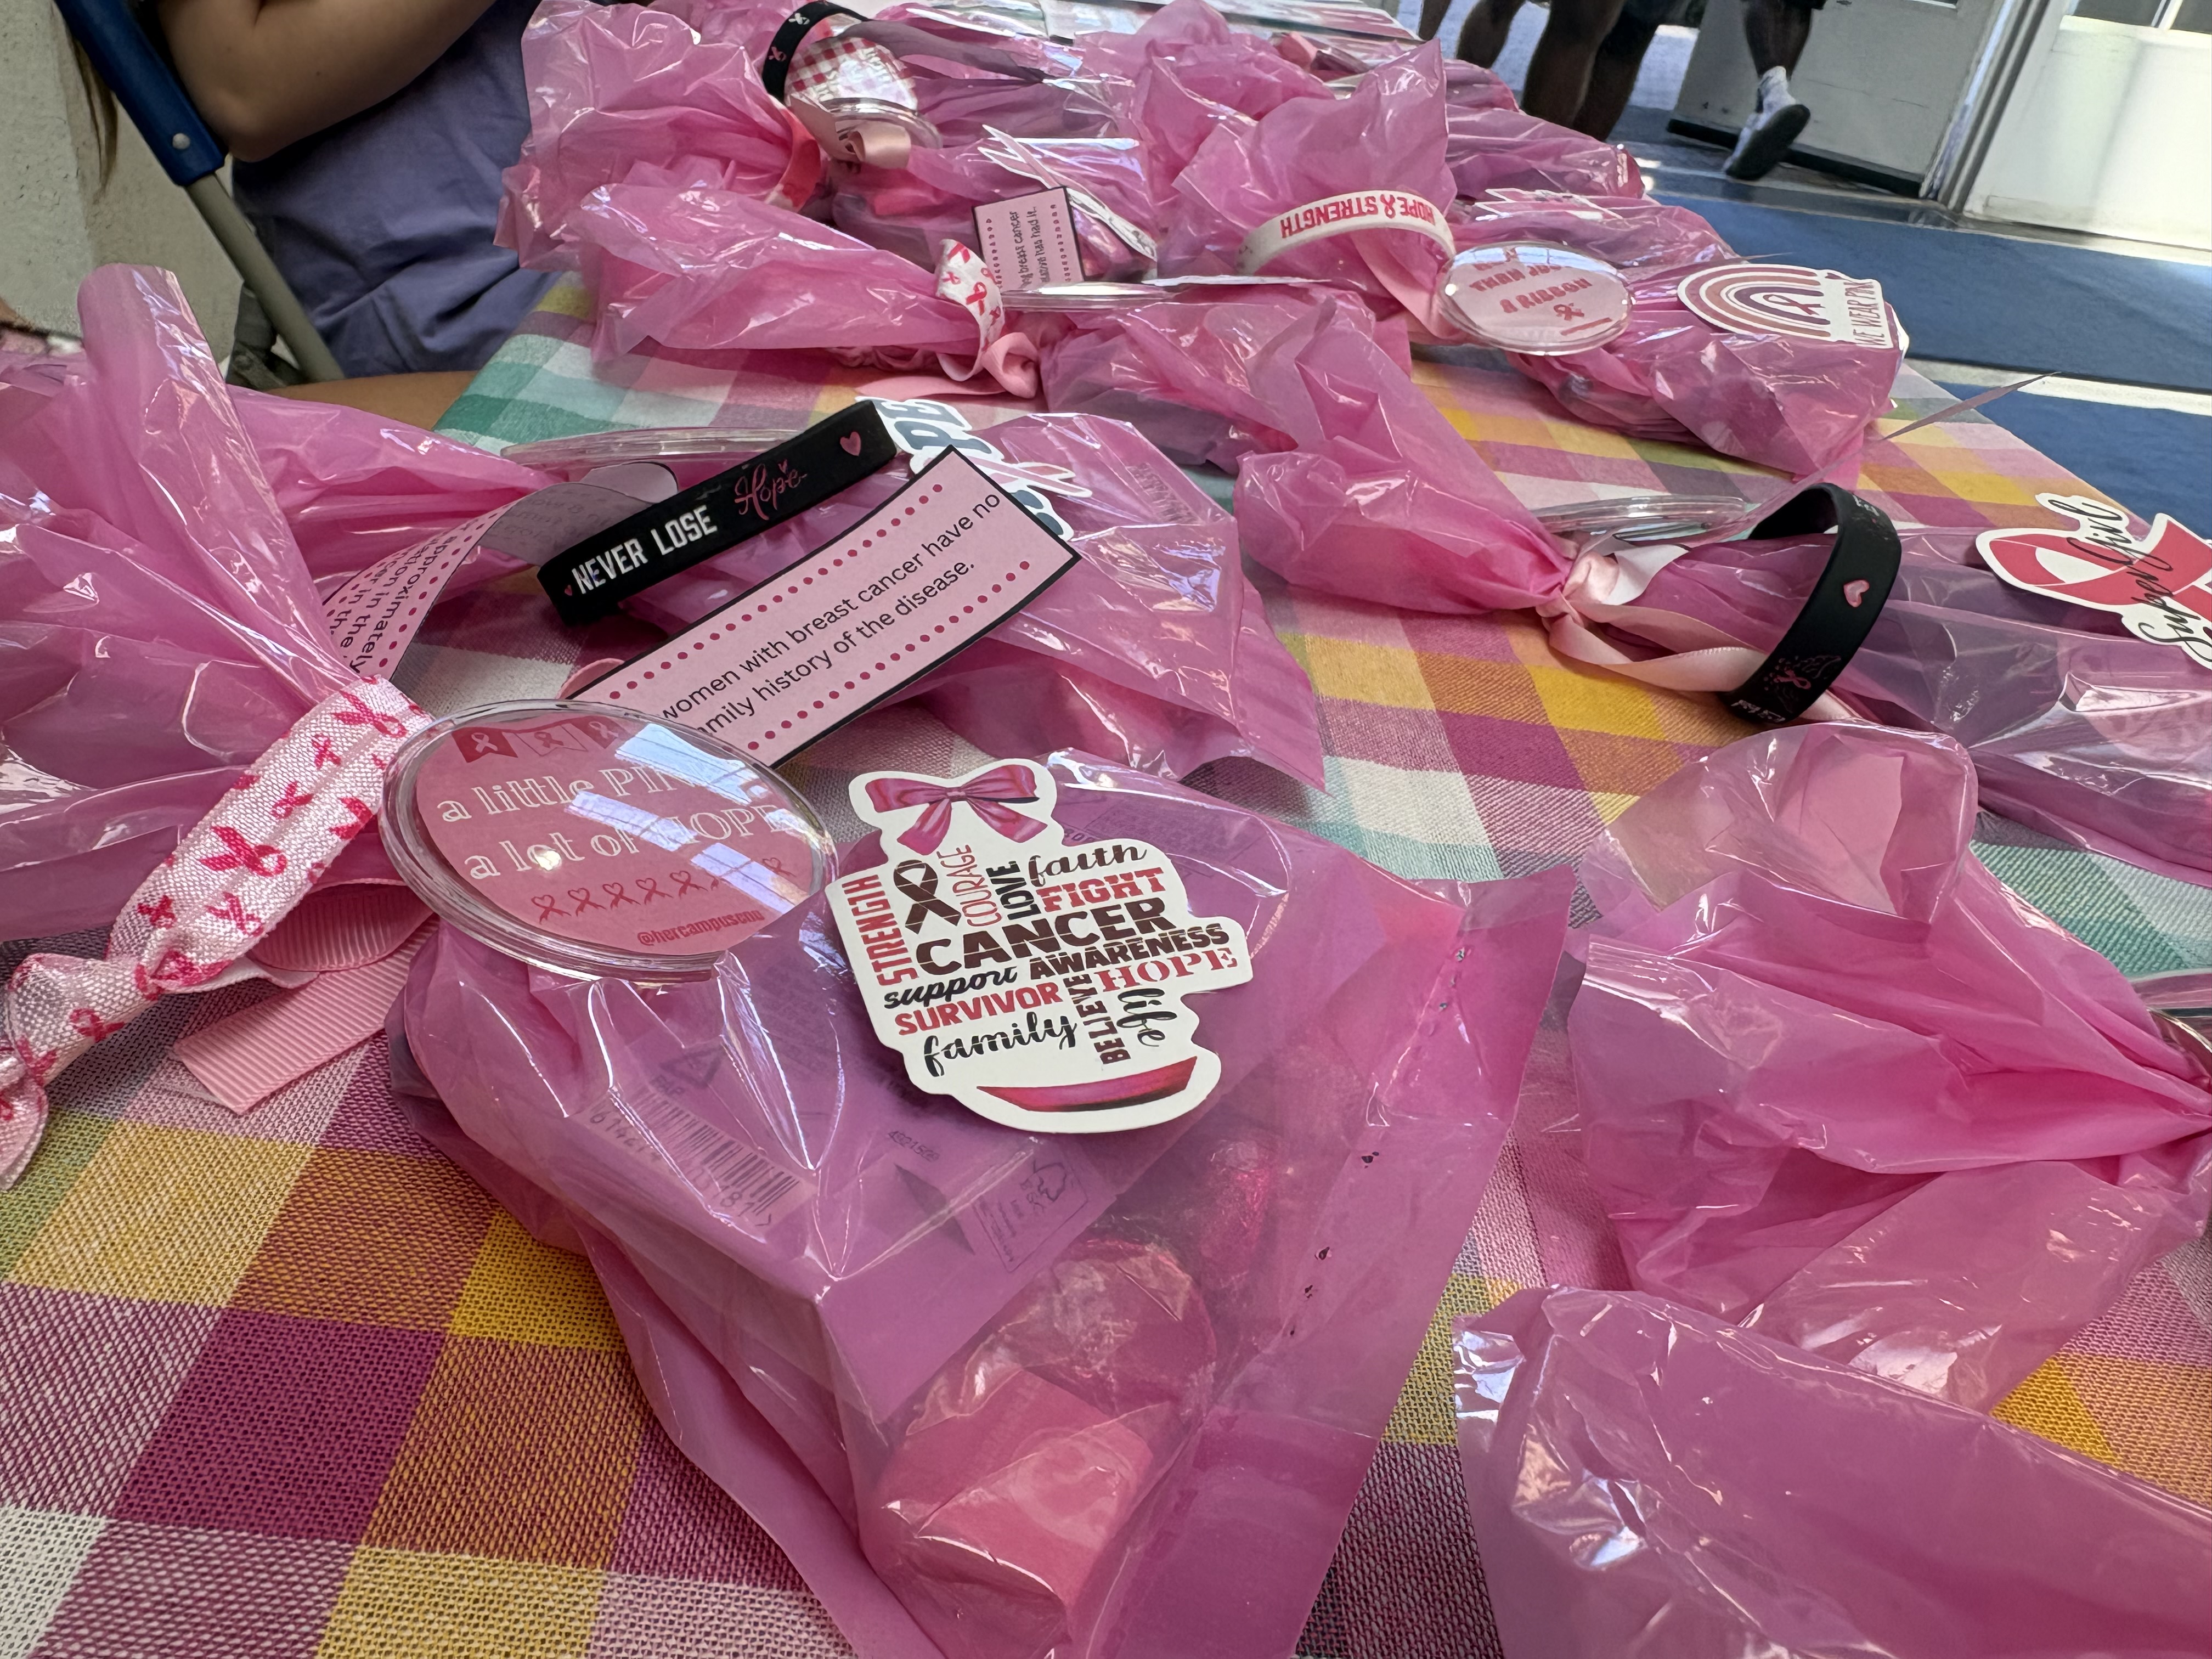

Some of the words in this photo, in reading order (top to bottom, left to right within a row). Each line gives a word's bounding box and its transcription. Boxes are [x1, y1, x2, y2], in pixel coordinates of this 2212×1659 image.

[1009, 211, 1023, 245] cancer
[1279, 198, 1379, 238] STRENGTH
[1515, 278, 1593, 309] RIBBON
[571, 538, 648, 594] NEVER
[651, 505, 718, 556] LOSE
[734, 462, 807, 520] Hope
[329, 609, 352, 635] th
[348, 588, 372, 604] in
[349, 536, 457, 673] approximately
[366, 591, 390, 608] in
[662, 668, 741, 720] women
[739, 637, 791, 673] with
[785, 596, 859, 645] breast
[857, 551, 922, 605] cancer
[921, 517, 974, 558] have
[971, 493, 1001, 523] no
[340, 614, 371, 648] the
[759, 648, 832, 703] history
[832, 629, 858, 654] of
[856, 608, 895, 643] the
[894, 560, 976, 616] disease.
[437, 799, 473, 823] a
[471, 777, 594, 816] little
[464, 853, 501, 880] a
[499, 831, 586, 872] lot
[590, 827, 641, 857] of
[1030, 844, 1148, 882] faith
[936, 844, 1004, 927] COURAGE
[986, 861, 1042, 921] LOVE
[1036, 867, 1166, 913] FIGHT
[841, 874, 919, 987] STRENGTH
[916, 897, 1177, 976] CANCER
[1030, 923, 1230, 981] AWARENESS
[883, 967, 1019, 1009] support
[1094, 946, 1238, 992] HOPE
[895, 982, 1063, 1036] SURVIVOR
[1063, 972, 1131, 1065] BELIEVE
[1117, 988, 1177, 1048] life
[922, 1011, 1077, 1077] family
